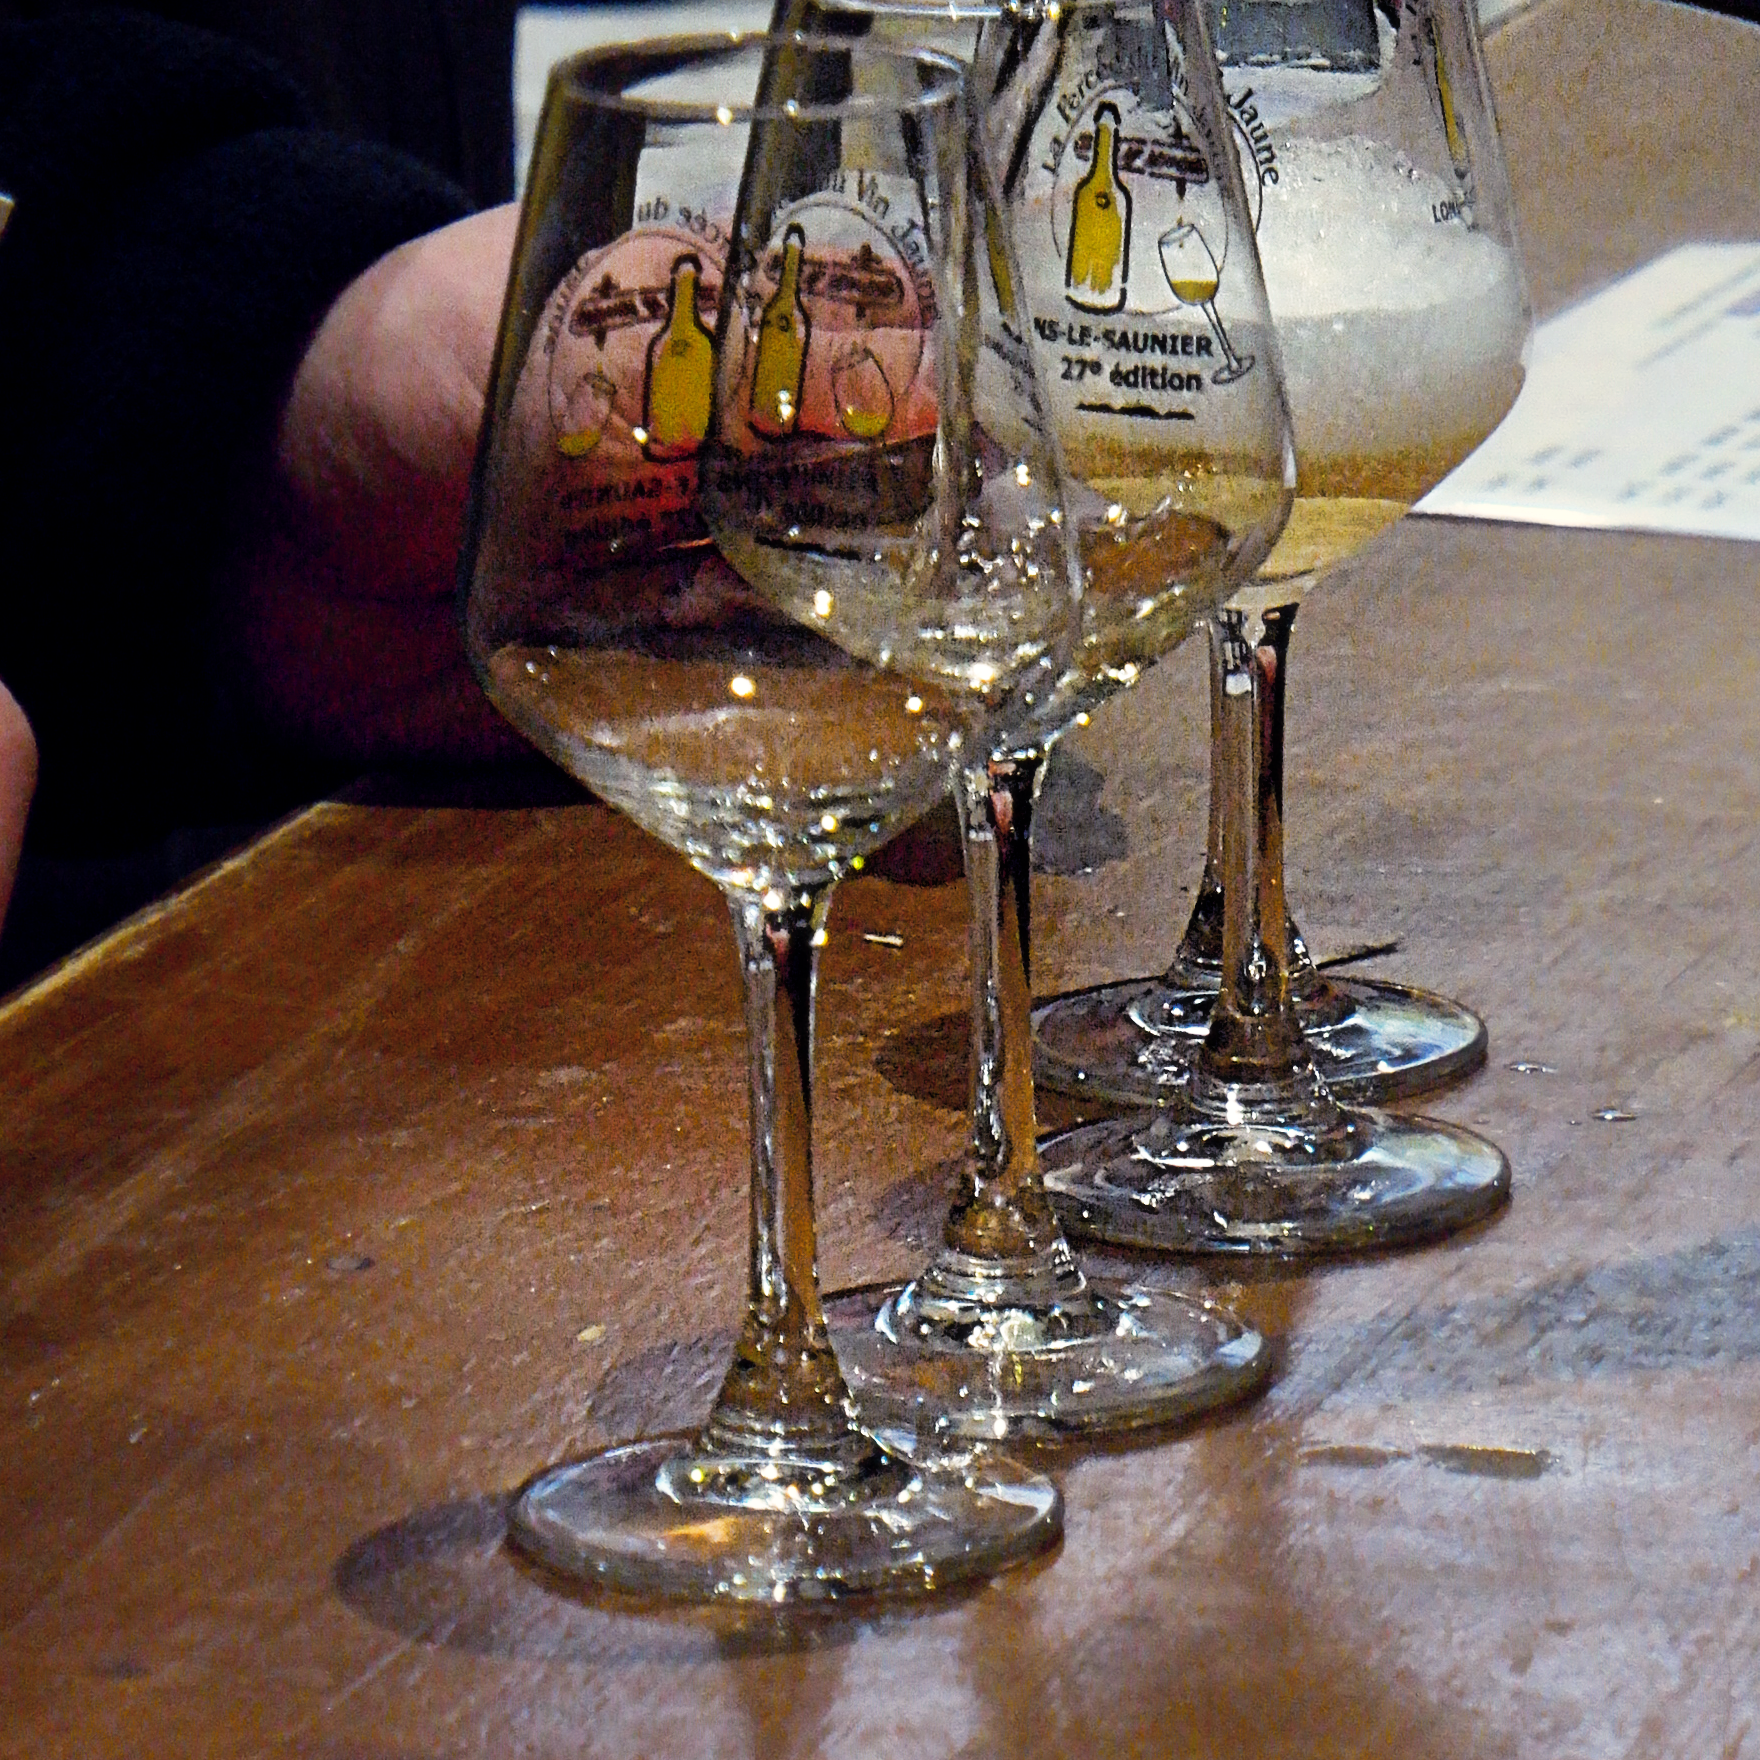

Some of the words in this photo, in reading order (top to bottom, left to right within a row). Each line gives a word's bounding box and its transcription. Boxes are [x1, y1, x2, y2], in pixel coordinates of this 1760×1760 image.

[1228, 88, 1280, 186] Jaune
[1033, 316, 1213, 357] NS-LE-SAUNIER
[1108, 361, 1204, 392] édition
